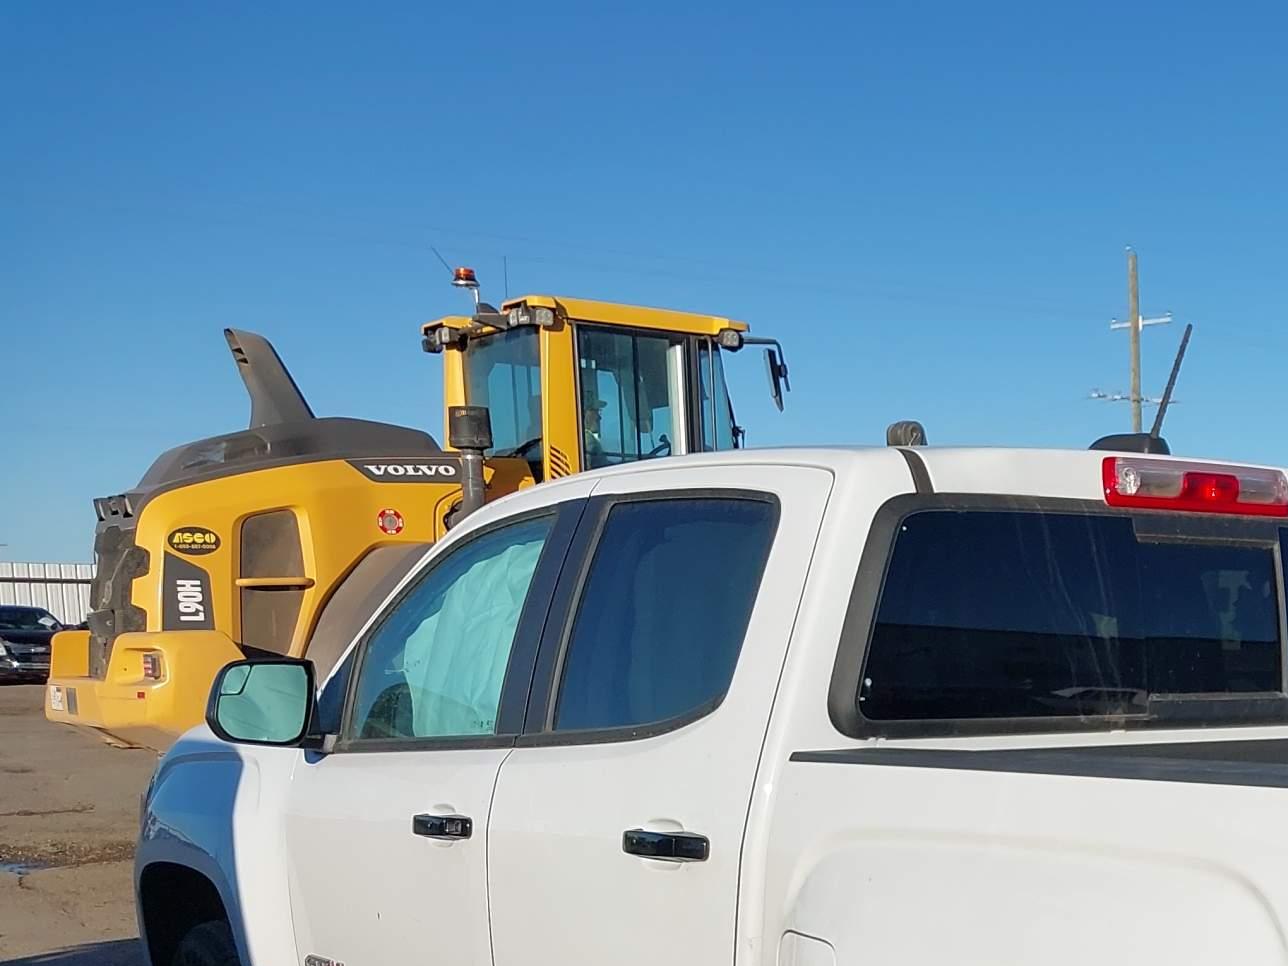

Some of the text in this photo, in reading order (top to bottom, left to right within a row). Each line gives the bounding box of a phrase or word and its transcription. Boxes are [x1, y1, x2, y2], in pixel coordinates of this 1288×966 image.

[364, 464, 456, 475] VOLVO
[173, 532, 216, 543] ASCO
[176, 580, 205, 621] L90H
